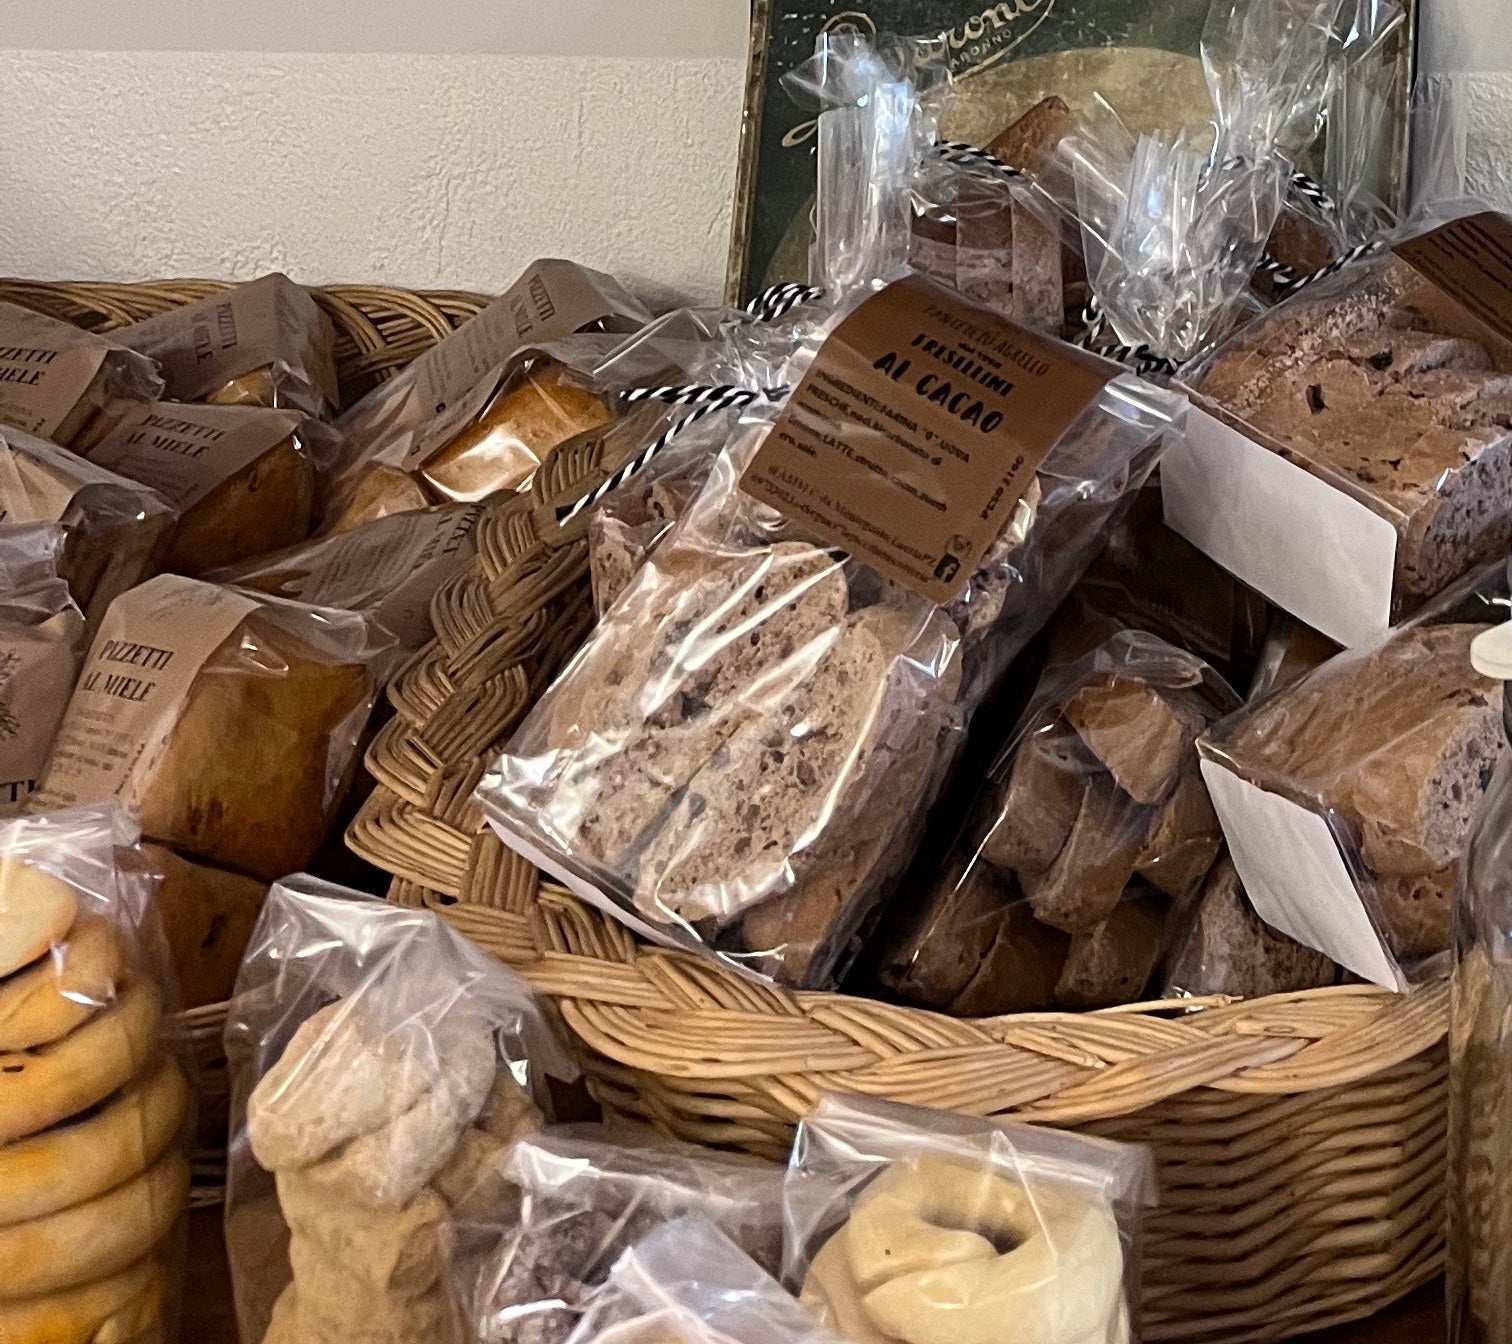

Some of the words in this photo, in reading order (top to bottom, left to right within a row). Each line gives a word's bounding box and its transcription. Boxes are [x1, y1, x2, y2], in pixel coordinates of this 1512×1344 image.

[950, 27, 1012, 72] ARONNO
[915, 373, 1005, 434] CACAO
[141, 414, 226, 442] PIZZETTI
[99, 639, 176, 672] PIZZETTI
[82, 671, 102, 692] AL
[104, 673, 157, 702] MIELE
